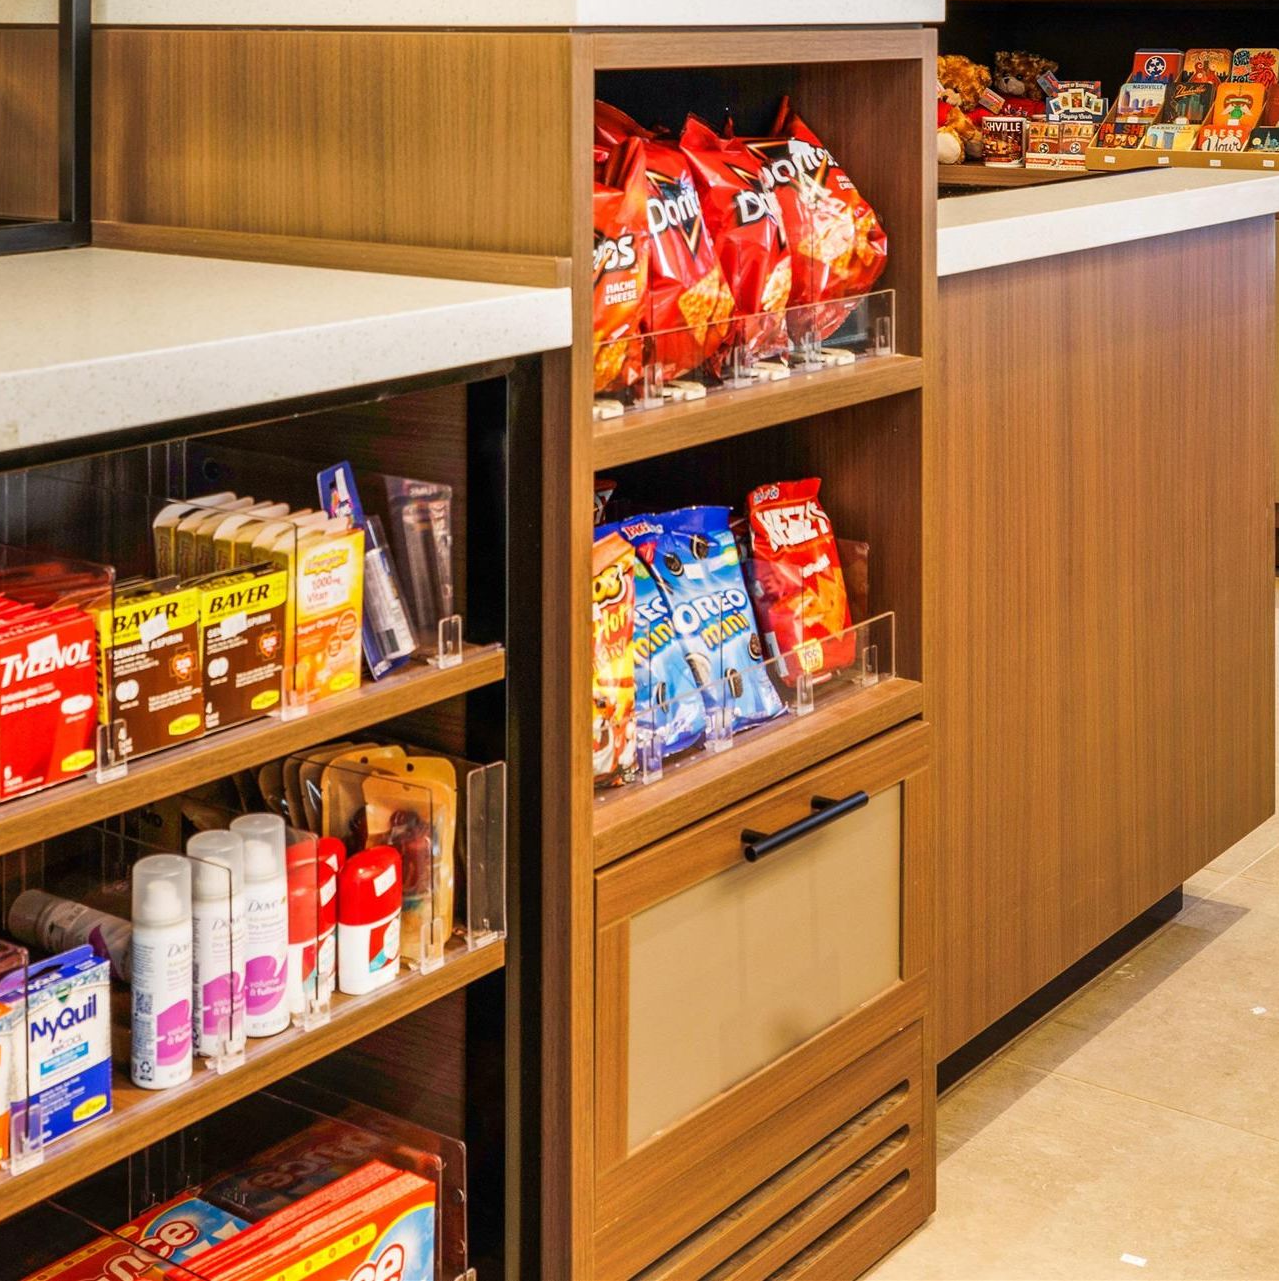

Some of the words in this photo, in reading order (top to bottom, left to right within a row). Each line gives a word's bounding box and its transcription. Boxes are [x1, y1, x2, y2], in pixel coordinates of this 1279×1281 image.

[1204, 129, 1243, 138] BLESS
[210, 584, 270, 613] BAYER
[672, 589, 747, 634] OREO
[113, 602, 178, 634] BAYER
[701, 609, 750, 651] mini
[248, 900, 277, 913] Dove
[31, 994, 97, 1044] NyQuil
